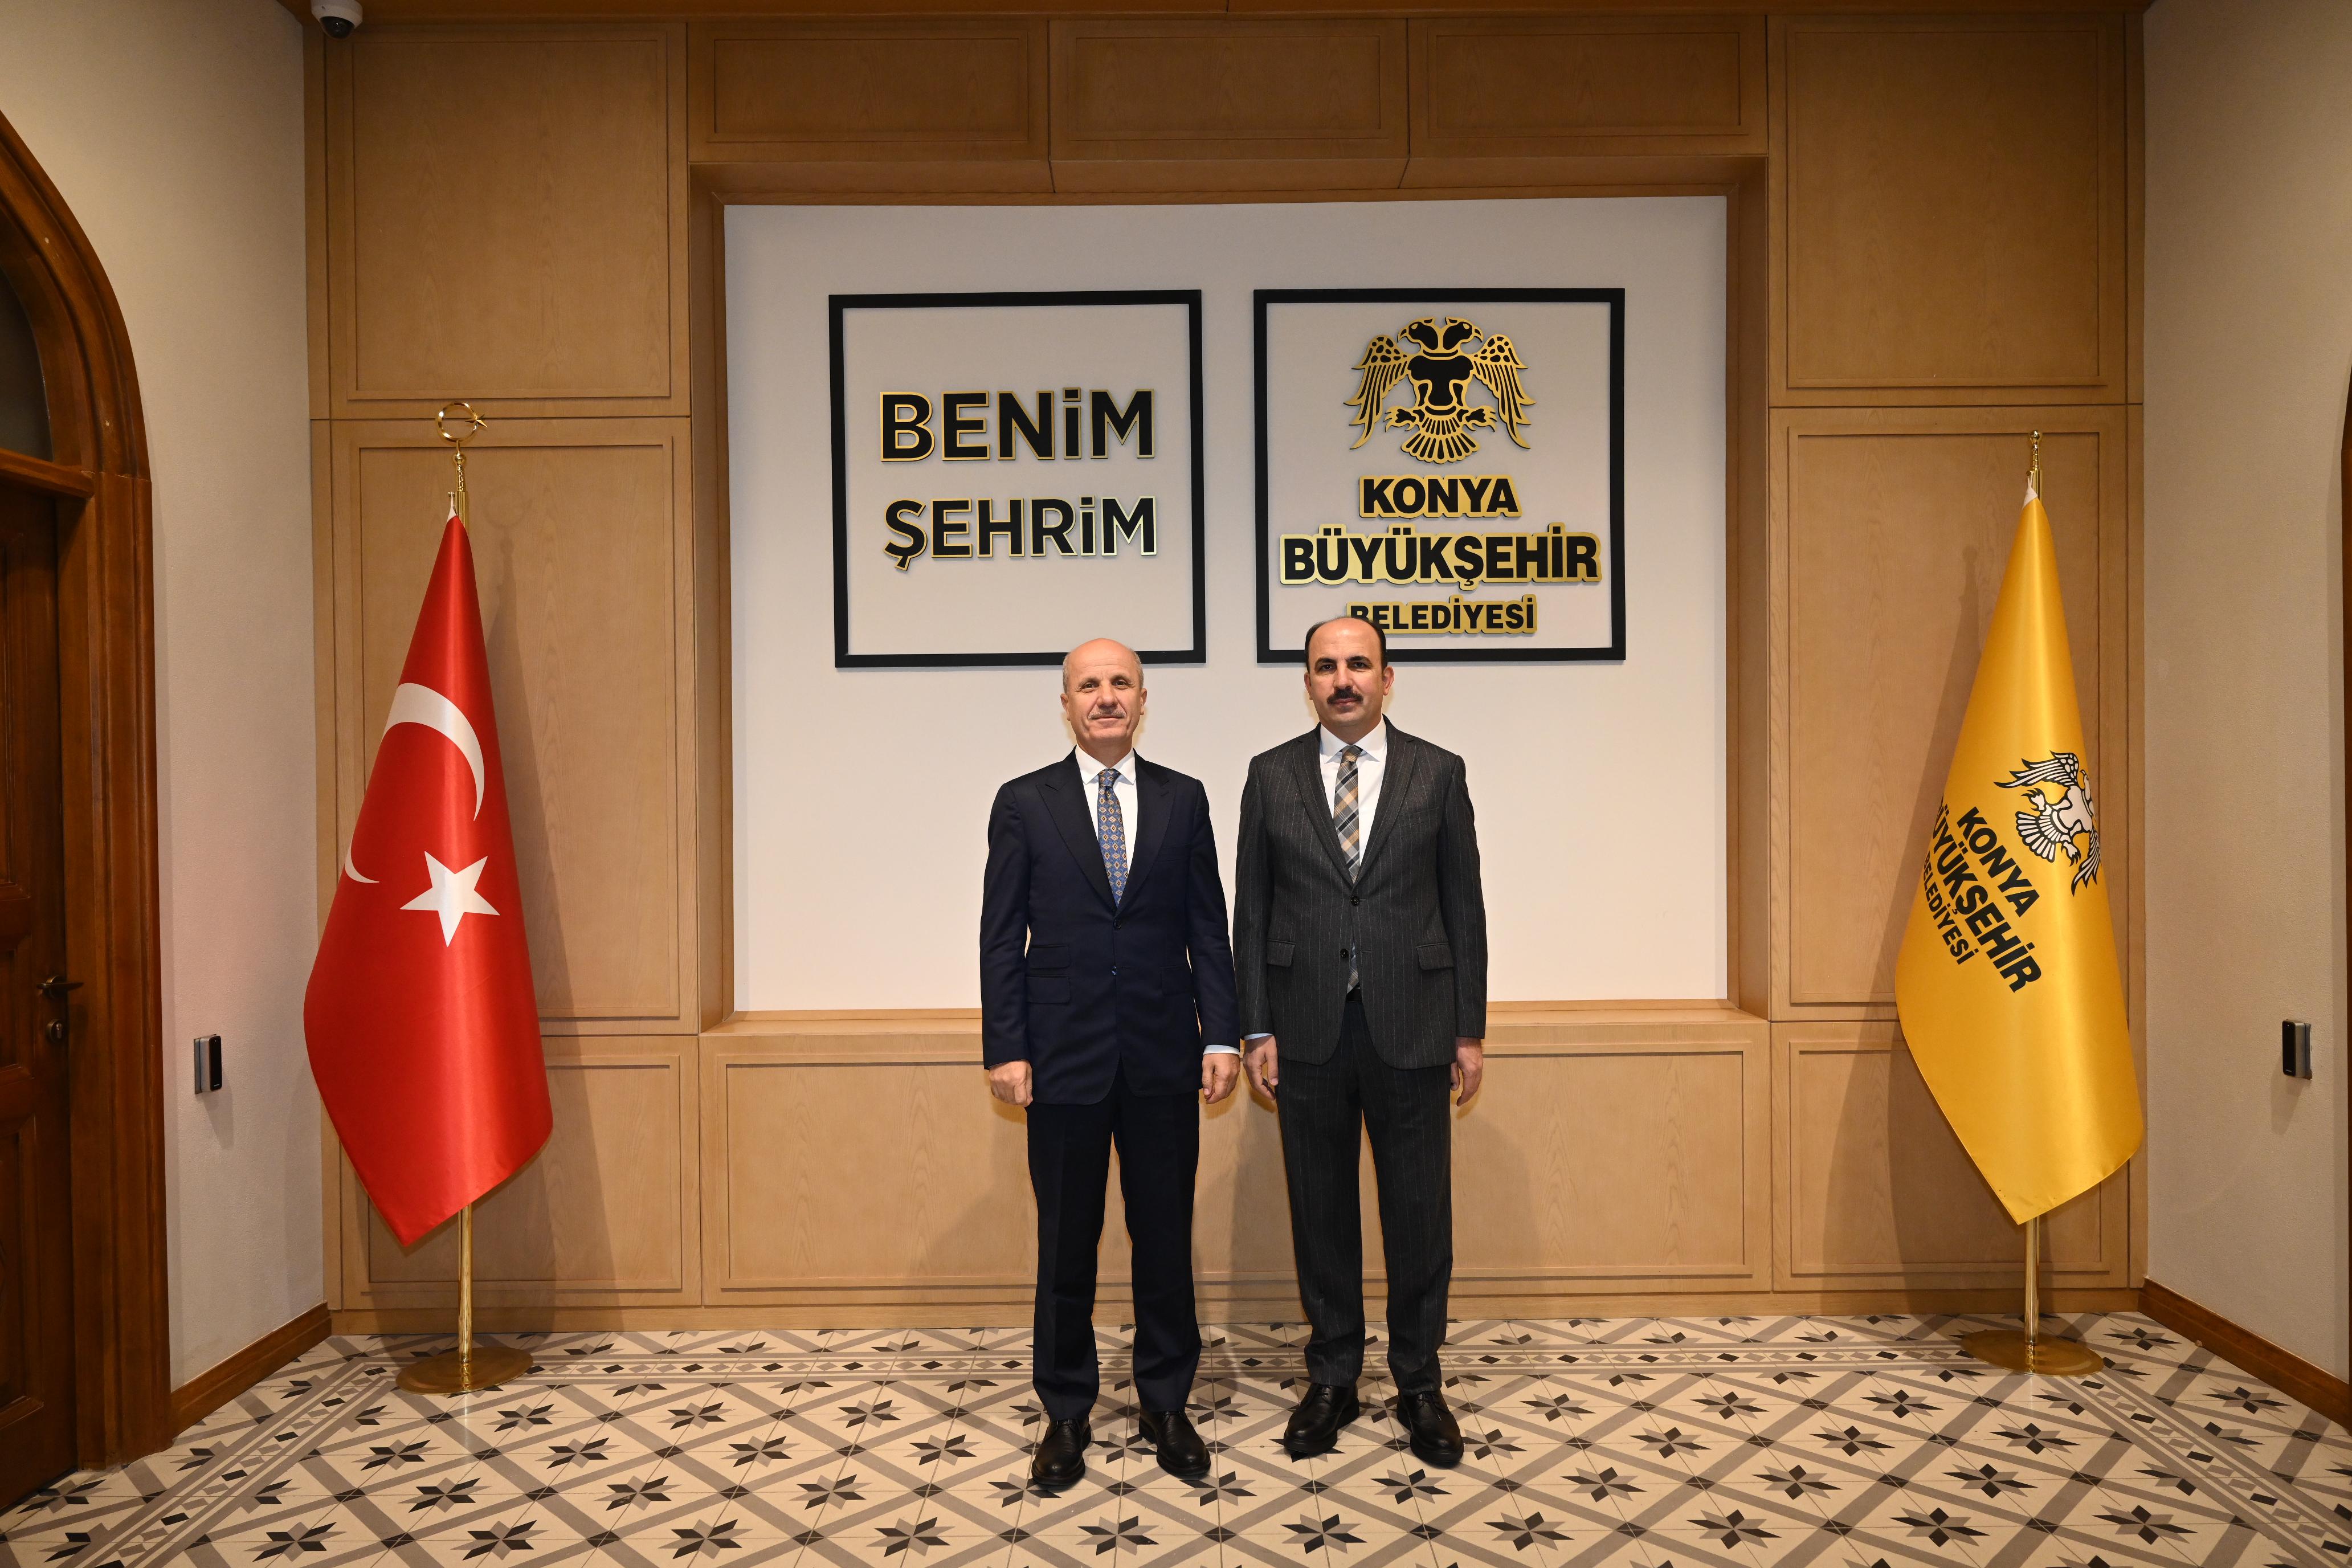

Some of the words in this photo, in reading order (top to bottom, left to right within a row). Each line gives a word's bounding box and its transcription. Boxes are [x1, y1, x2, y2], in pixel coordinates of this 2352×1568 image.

[880, 387, 1155, 462] BENİM
[883, 495, 1157, 571] ŞEHRİM
[1362, 478, 1518, 514] KONYA
[1284, 527, 1598, 586] BÜYÜKŞEHİR
[1933, 794, 2041, 993] ÜYÜKŞEHİR
[1957, 806, 2040, 917] KONYA
[1924, 851, 1979, 965] BELEDİYESİ
